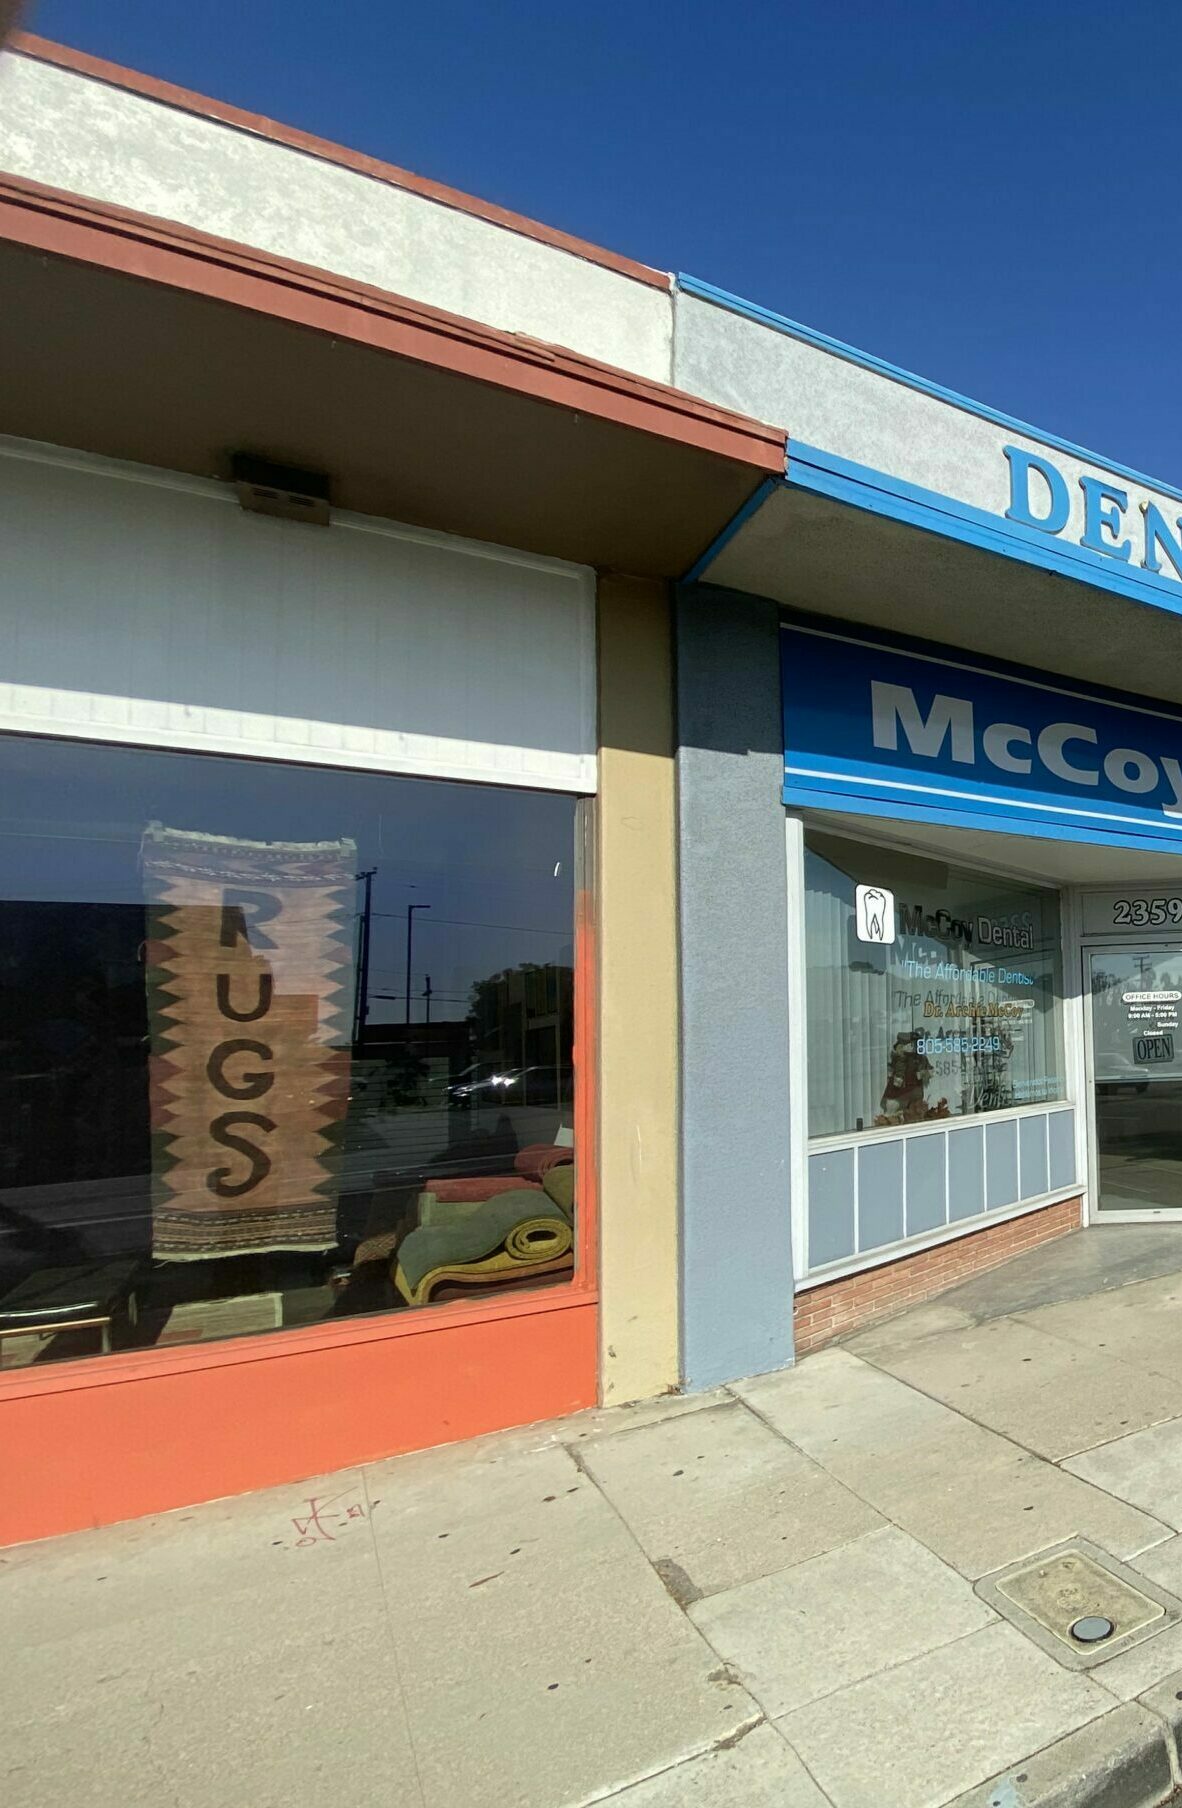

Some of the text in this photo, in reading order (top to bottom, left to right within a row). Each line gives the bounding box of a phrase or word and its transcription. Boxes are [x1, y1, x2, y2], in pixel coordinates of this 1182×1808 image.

[899, 903, 974, 951] McCoy
[976, 915, 1034, 950] Dental
[935, 963, 996, 984] Affordable
[1125, 992, 1179, 1001] OFFICE HOURS
[923, 1002, 944, 1018] Dr.
[987, 1003, 1025, 1021] McCoy
[206, 888, 283, 1198] RUGS
[916, 1037, 1000, 1056] 805-585-2249
[1137, 1038, 1170, 1060] OPEN
